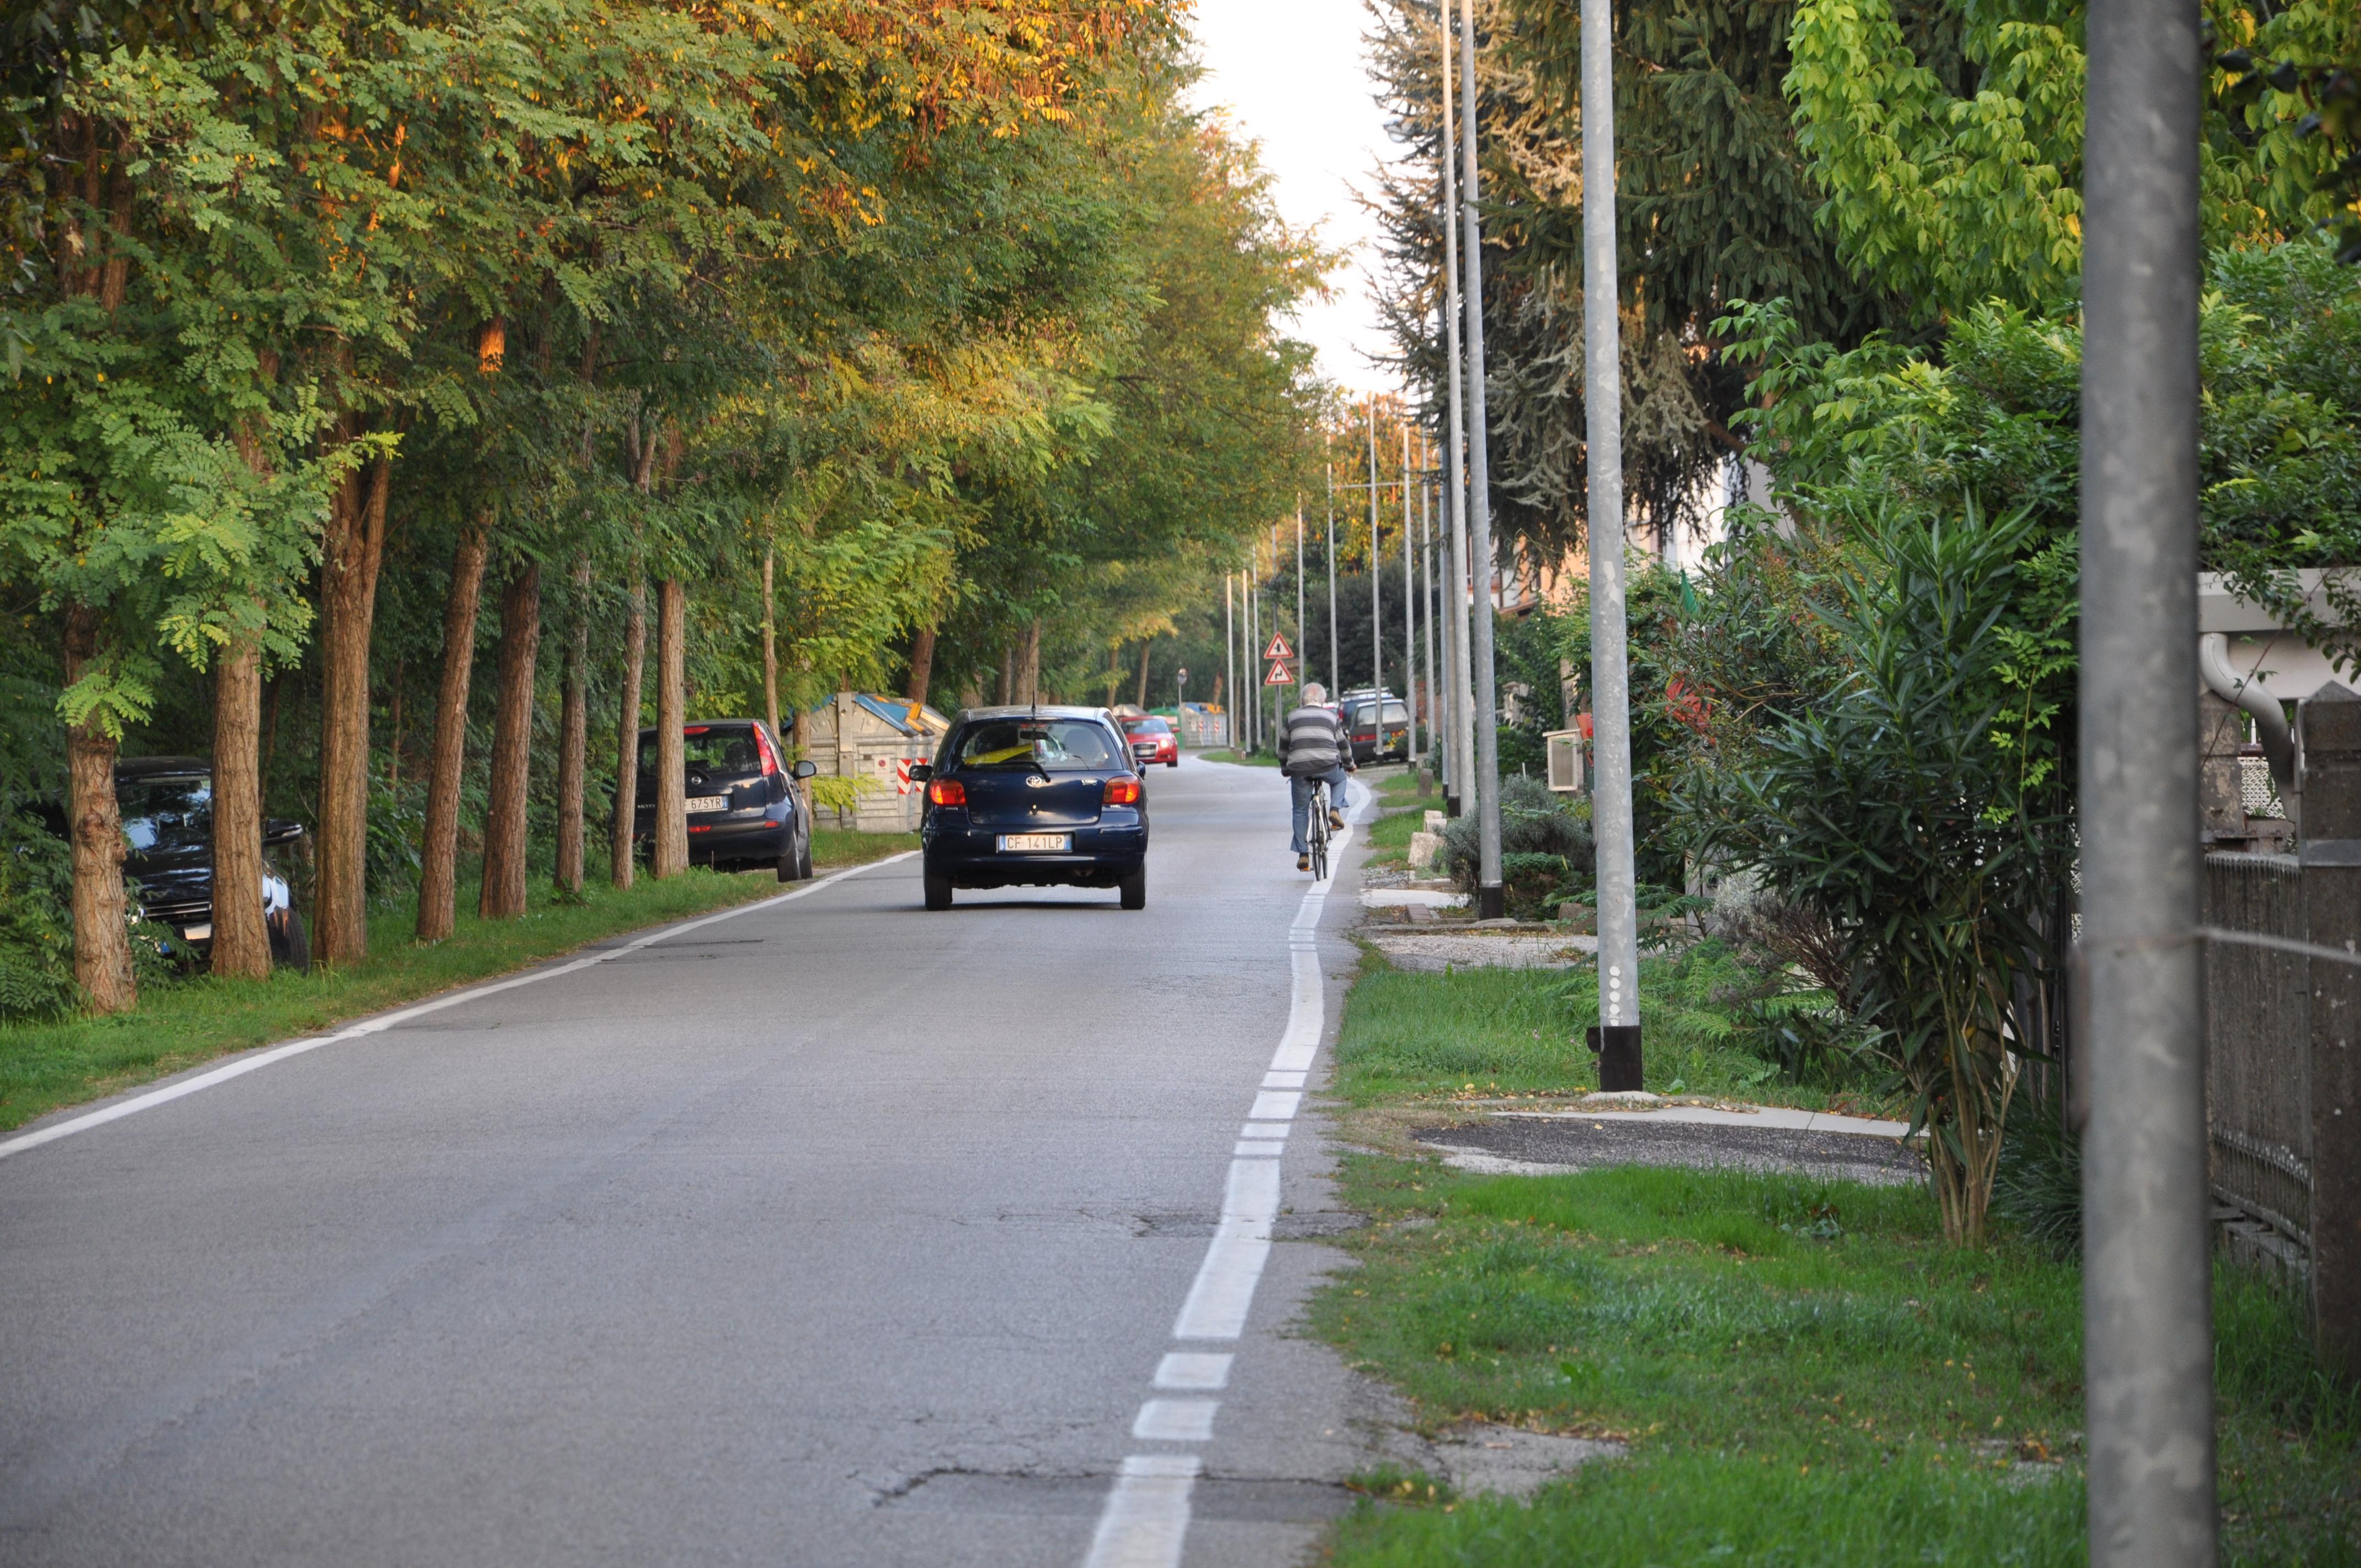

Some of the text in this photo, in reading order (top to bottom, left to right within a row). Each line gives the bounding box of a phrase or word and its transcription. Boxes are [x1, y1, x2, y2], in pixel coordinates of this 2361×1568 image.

[691, 798, 721, 809] 675YR
[1007, 836, 1062, 849] CF 141LP
